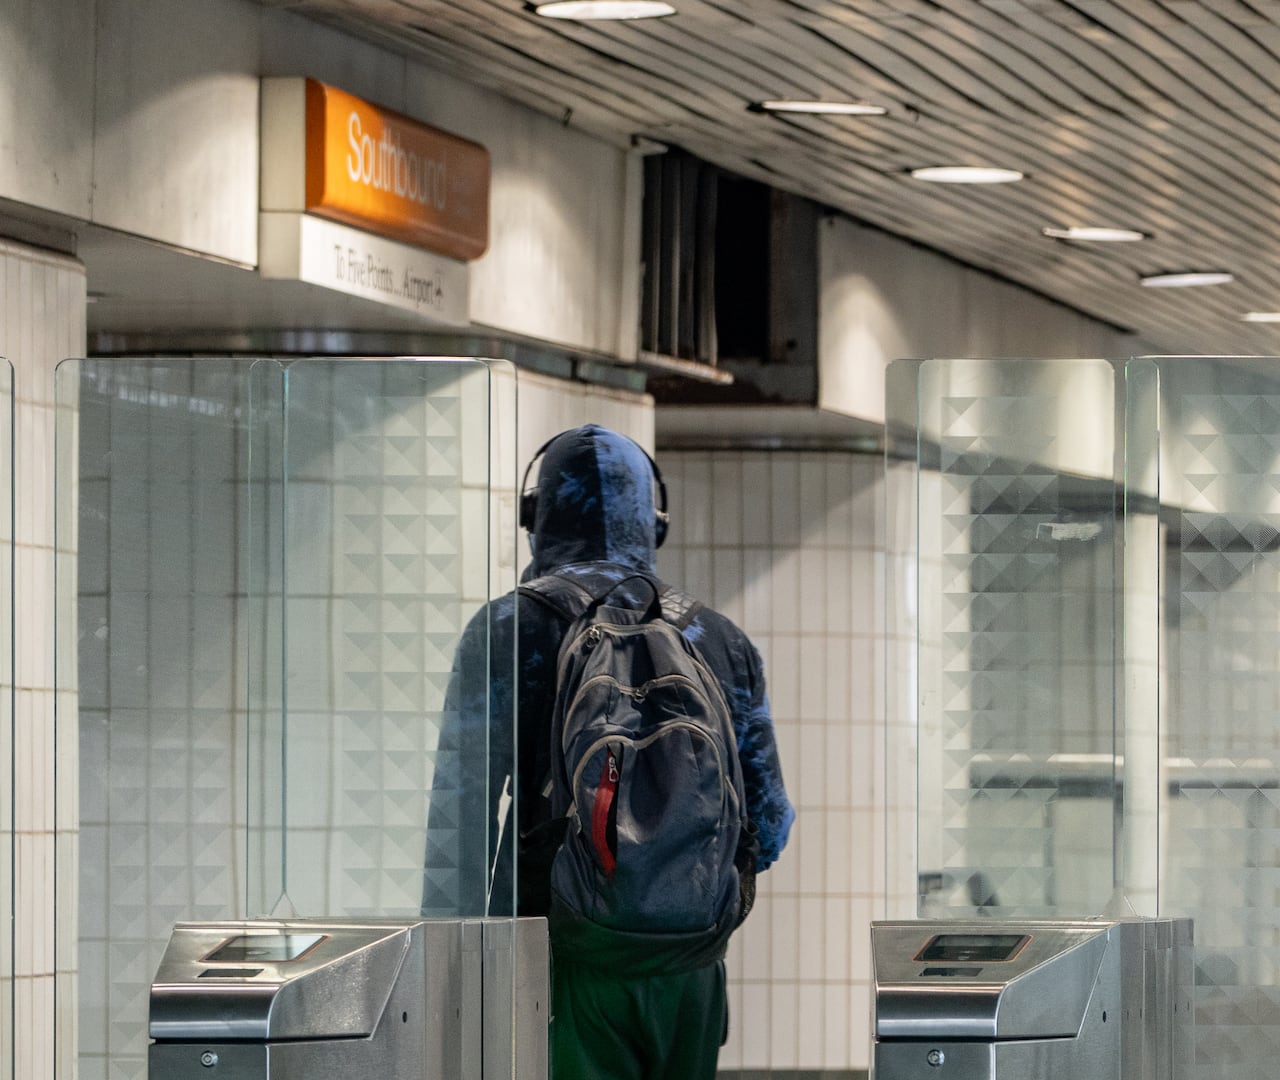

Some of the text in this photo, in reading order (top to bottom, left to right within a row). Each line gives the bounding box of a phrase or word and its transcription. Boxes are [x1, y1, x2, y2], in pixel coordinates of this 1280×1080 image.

[346, 111, 447, 211] Southbound
[334, 245, 345, 281] To
[348, 249, 366, 288] Five
